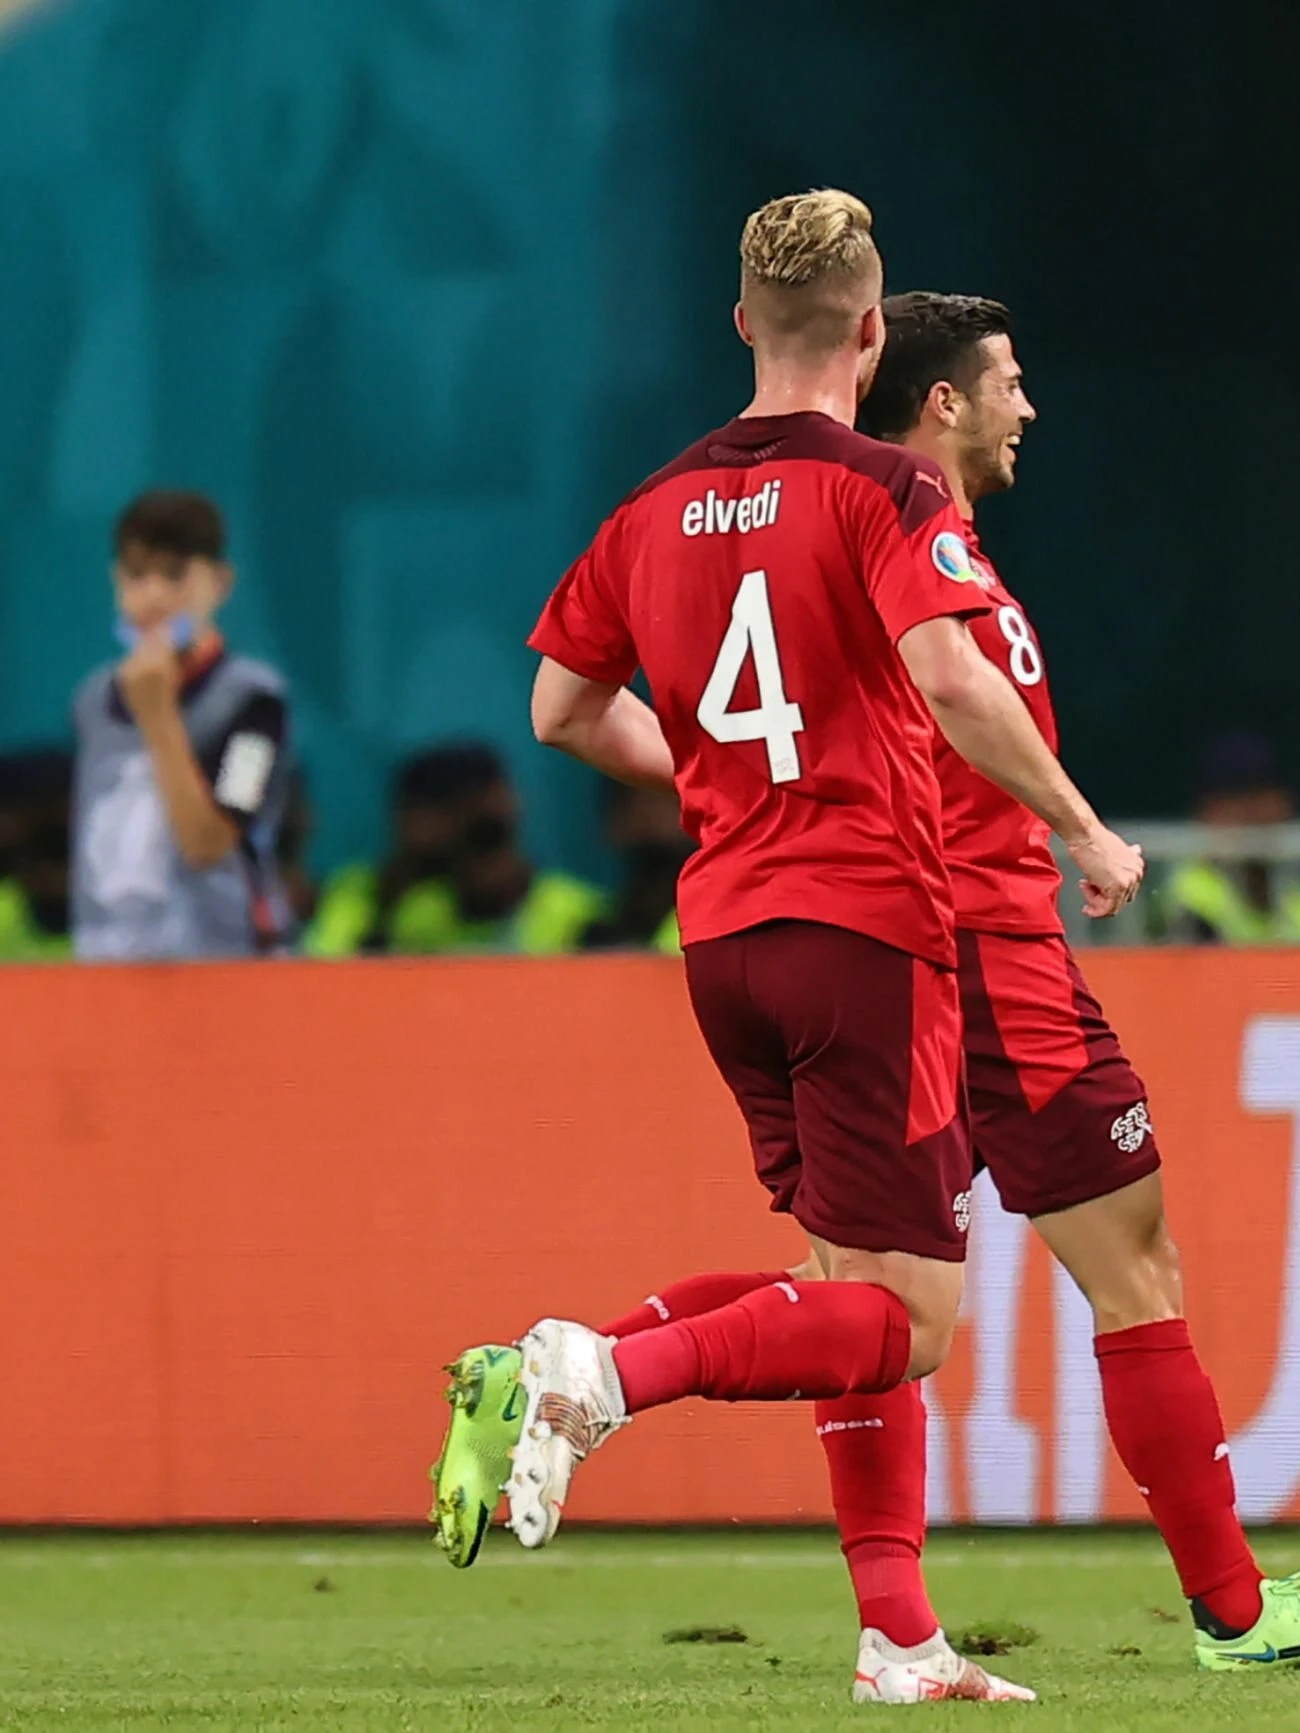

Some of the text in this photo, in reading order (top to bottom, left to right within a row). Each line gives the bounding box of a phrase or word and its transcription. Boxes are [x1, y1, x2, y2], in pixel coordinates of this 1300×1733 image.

[682, 479, 781, 536] elvedi
[697, 569, 803, 784] 4
[998, 606, 1042, 686] 8
